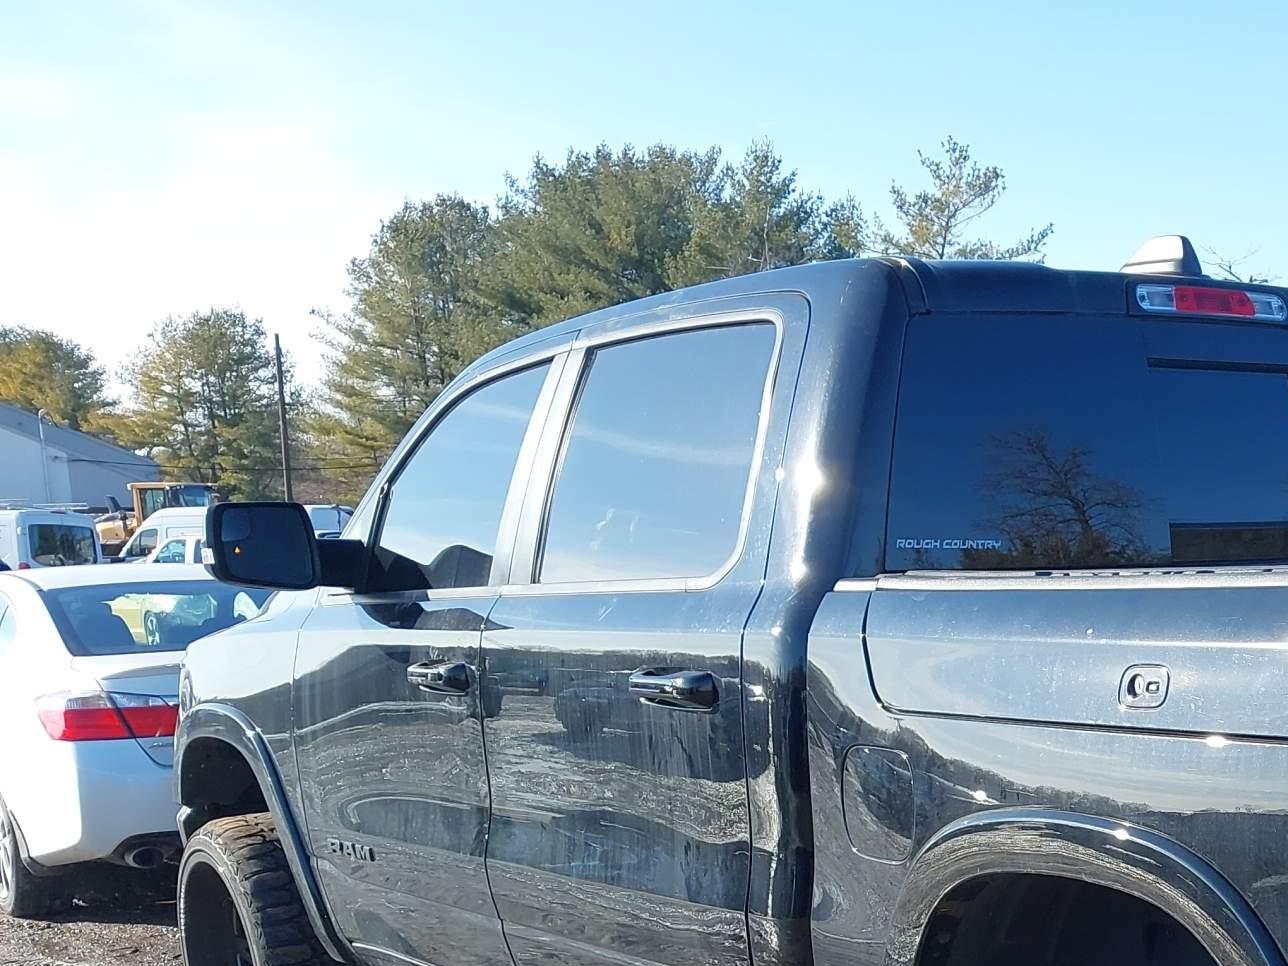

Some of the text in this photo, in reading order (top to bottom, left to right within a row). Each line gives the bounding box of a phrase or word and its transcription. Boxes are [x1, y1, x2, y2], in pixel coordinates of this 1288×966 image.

[896, 539, 1002, 550] ROUGH COUNTRY
[327, 838, 377, 862] RAM
